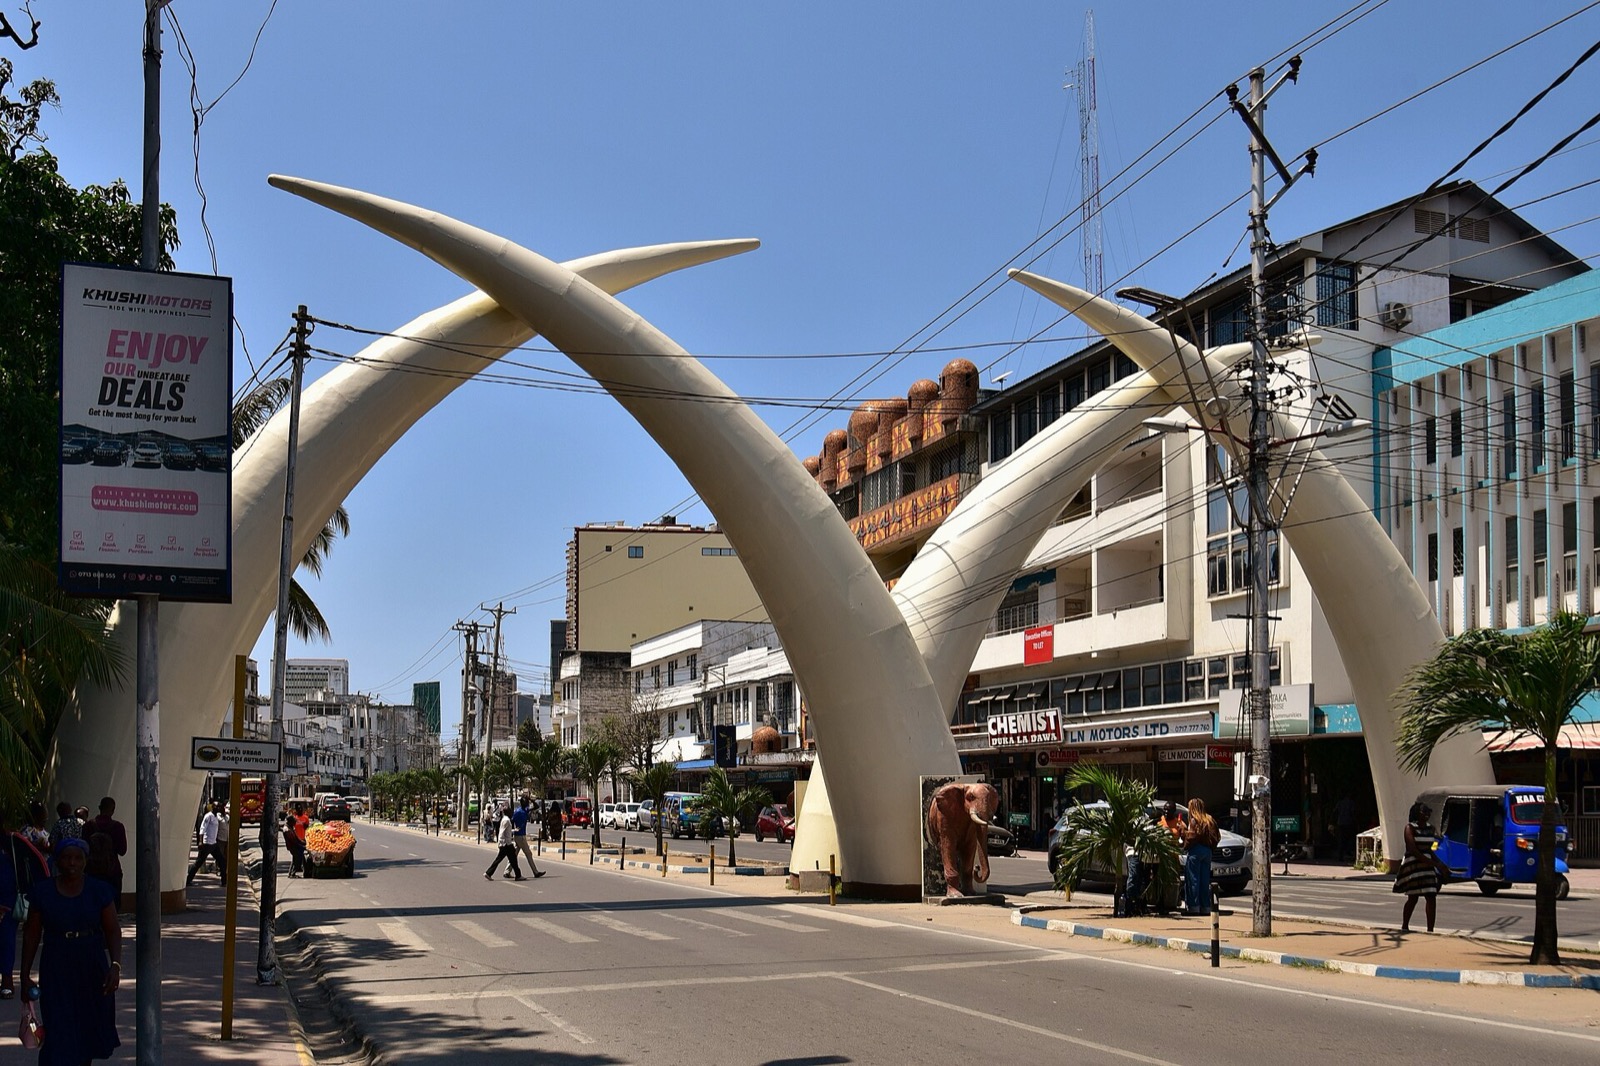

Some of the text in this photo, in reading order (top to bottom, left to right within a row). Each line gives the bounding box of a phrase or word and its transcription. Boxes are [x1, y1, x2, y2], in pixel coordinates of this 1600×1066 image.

[149, 308, 186, 317] HAPPINESS
[106, 329, 209, 369] ENJOY
[103, 361, 190, 383] OUR UNBEATABLE
[98, 376, 186, 412] DEALS
[88, 407, 197, 423] Get the most bang for your buck
[93, 497, 197, 511] www.khushimotors.com
[1033, 642, 1037, 650] TO
[988, 710, 1057, 736] CHEMIST
[991, 732, 1057, 746] DUKA LA DAWA
[1070, 730, 1085, 742] LN
[1090, 725, 1139, 741] MOTORS
[1145, 723, 1169, 737] LTD
[1189, 724, 1199, 732] 777
[222, 755, 242, 763] ROADS
[1050, 750, 1079, 758] CITADEL
[1167, 750, 1205, 760] LN MOTORS
[1515, 794, 1536, 804] KAA
